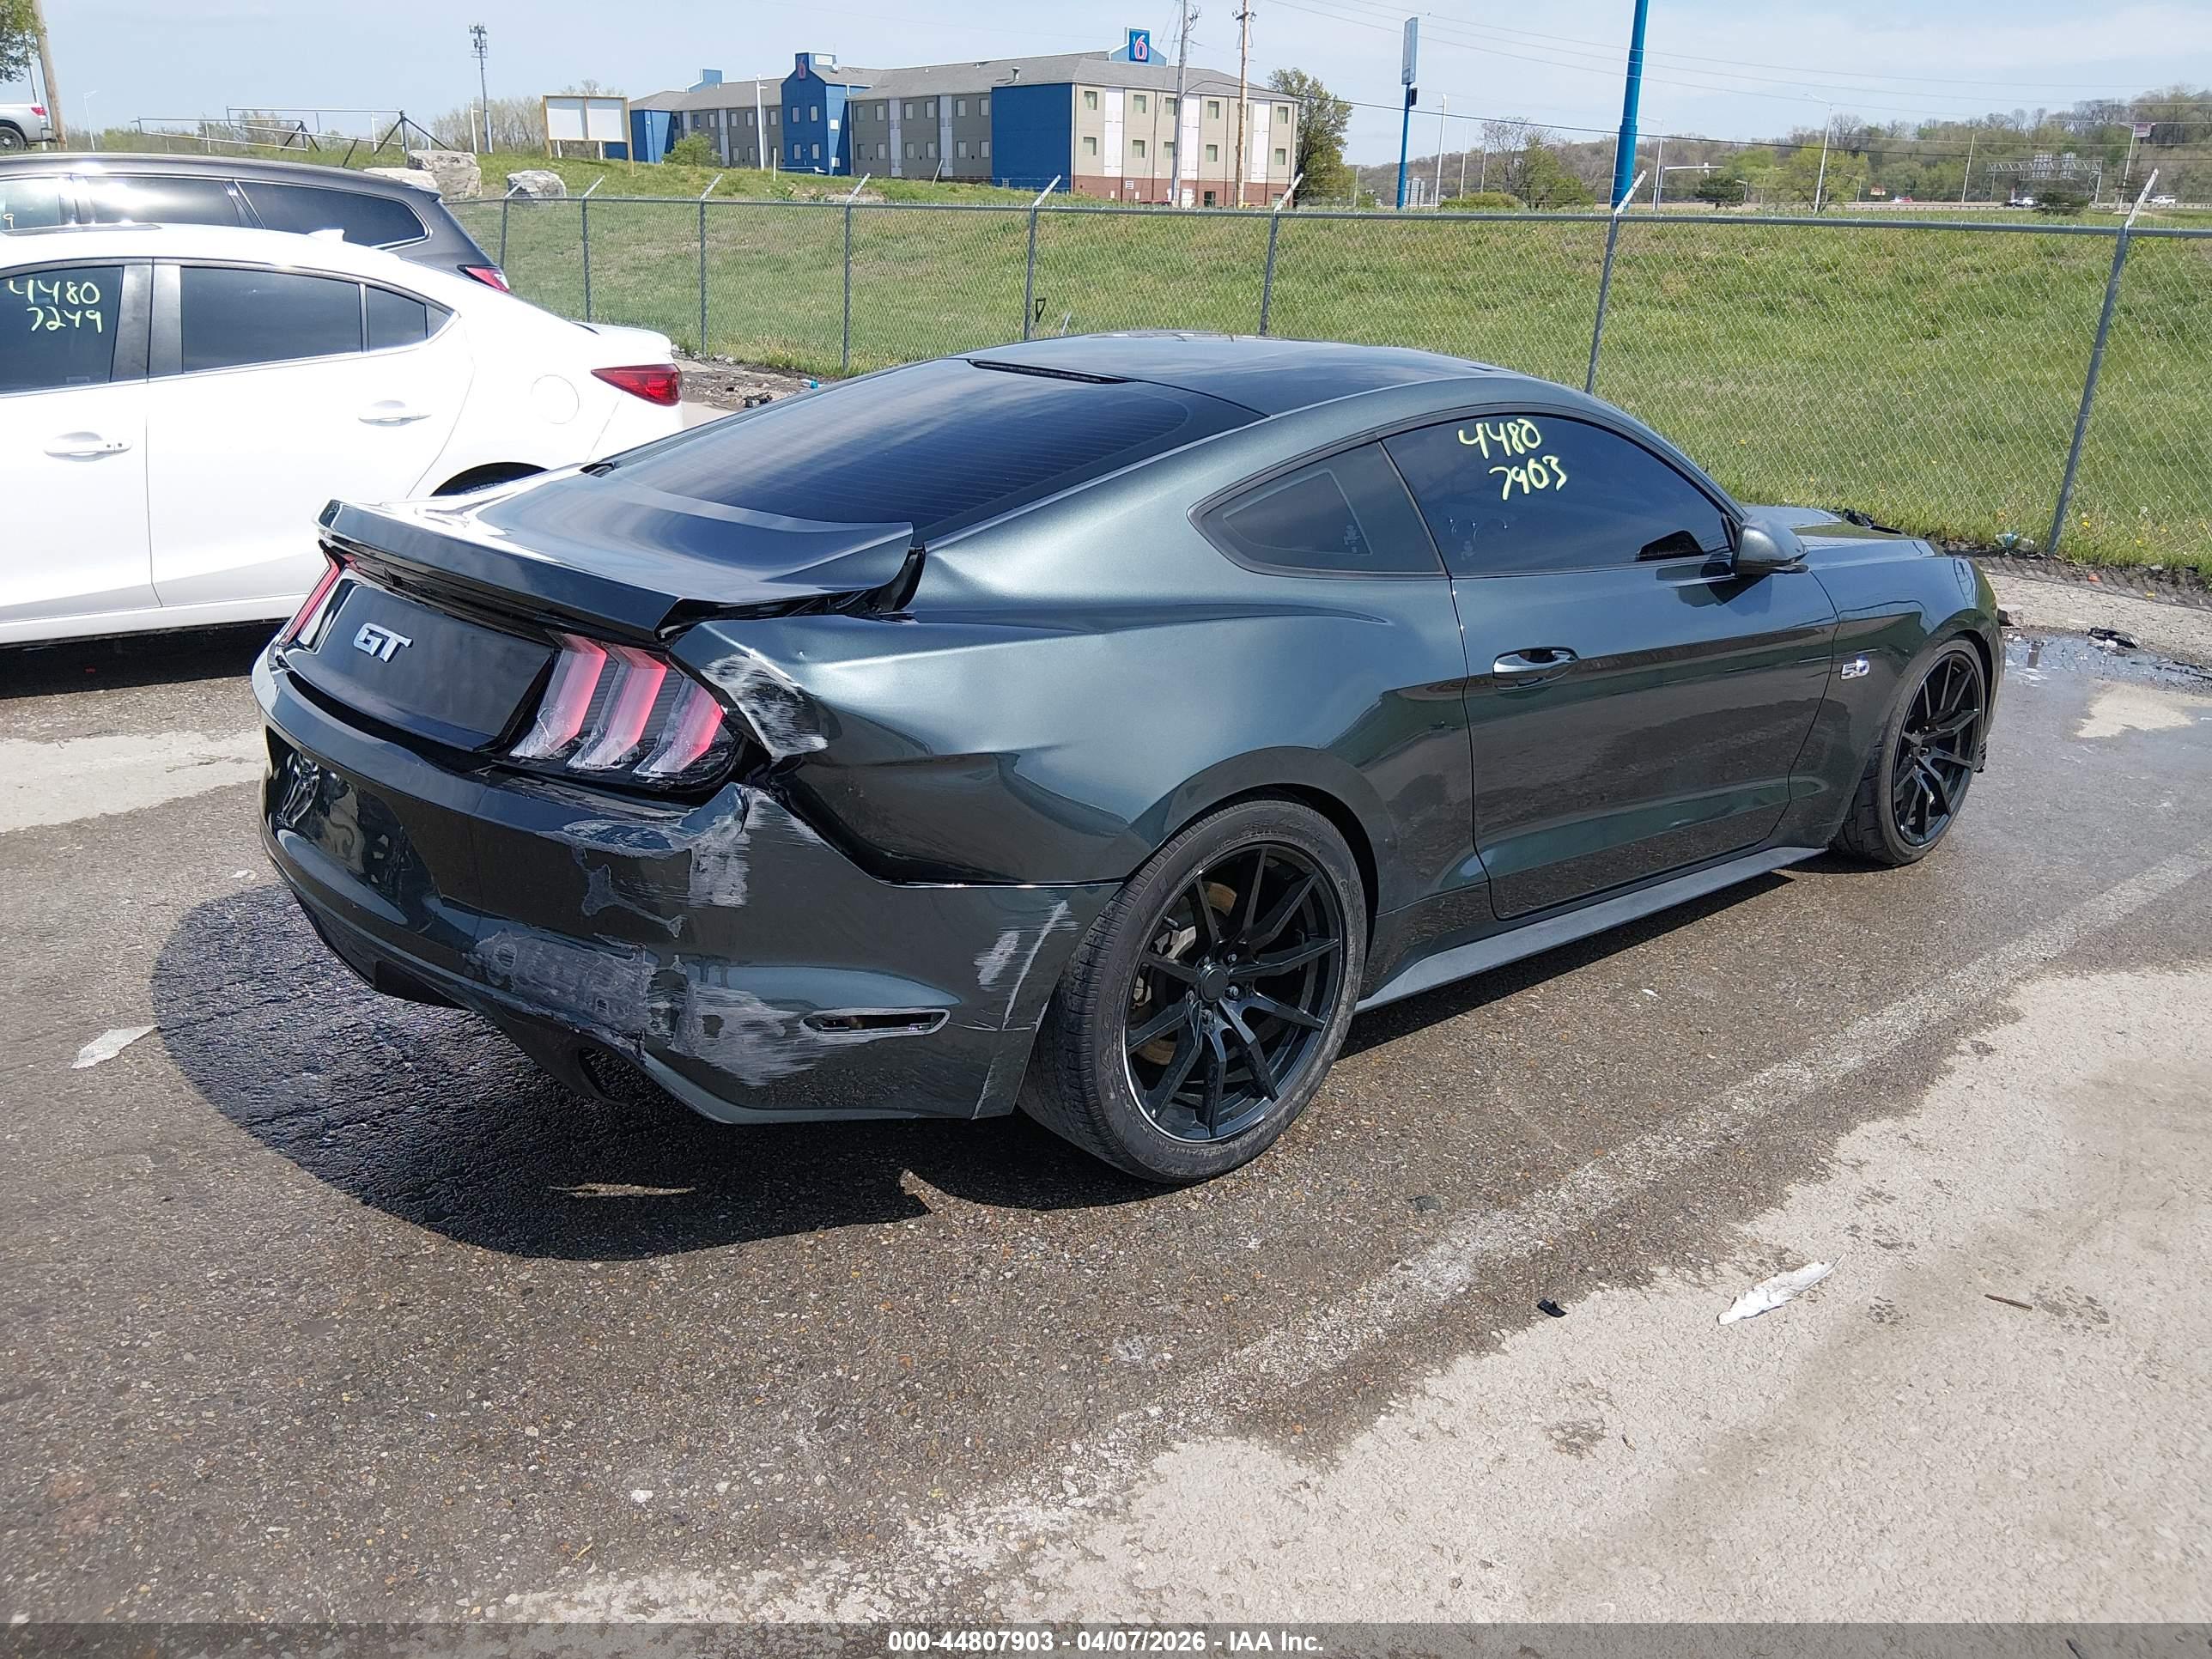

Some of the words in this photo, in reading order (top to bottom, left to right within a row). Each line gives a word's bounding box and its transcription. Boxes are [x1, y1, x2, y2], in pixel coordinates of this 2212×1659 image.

[1134, 34, 1148, 60] 6
[9, 279, 100, 306] 4480
[26, 306, 103, 334] 7249
[1457, 418, 1542, 459] 4480
[1488, 455, 1568, 501] 7903
[353, 622, 414, 663] GT
